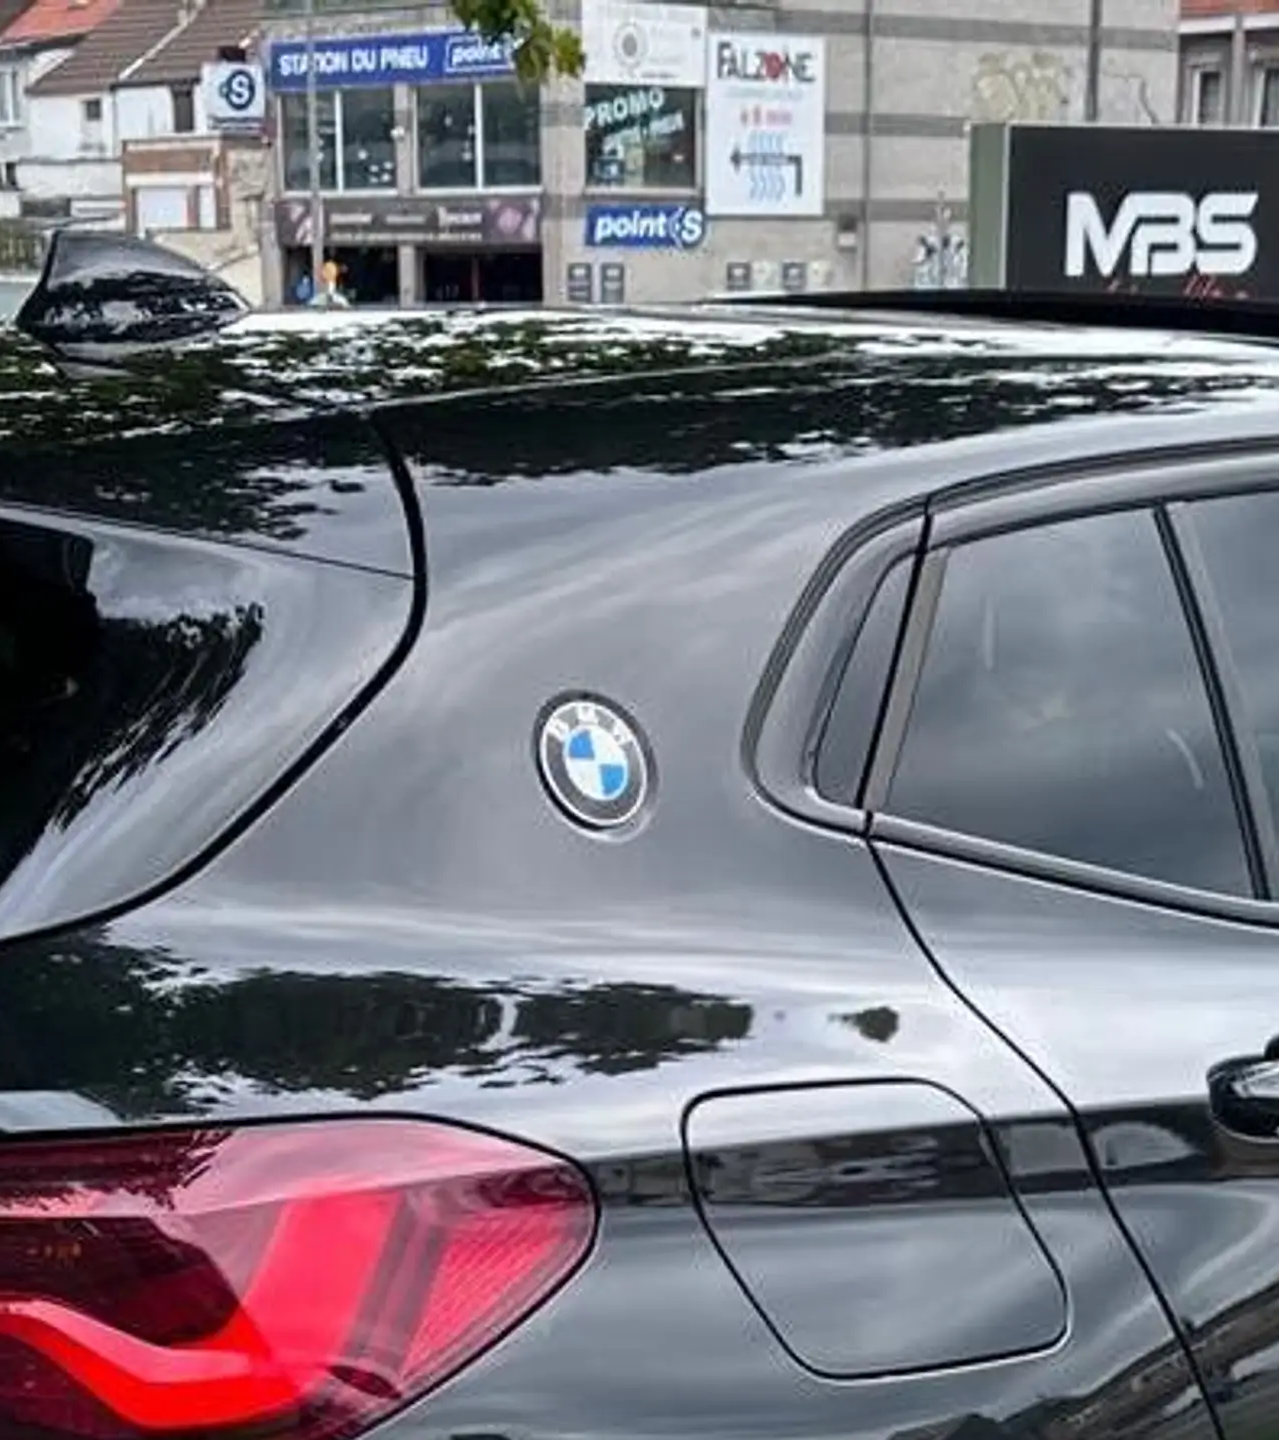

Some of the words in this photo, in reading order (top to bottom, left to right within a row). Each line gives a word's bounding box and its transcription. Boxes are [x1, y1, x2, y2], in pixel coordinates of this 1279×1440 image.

[351, 48, 377, 72] DU
[380, 44, 428, 70] PNEU
[583, 86, 665, 131] PROMO
[594, 210, 666, 243] point
[1065, 191, 1260, 278] MBS
